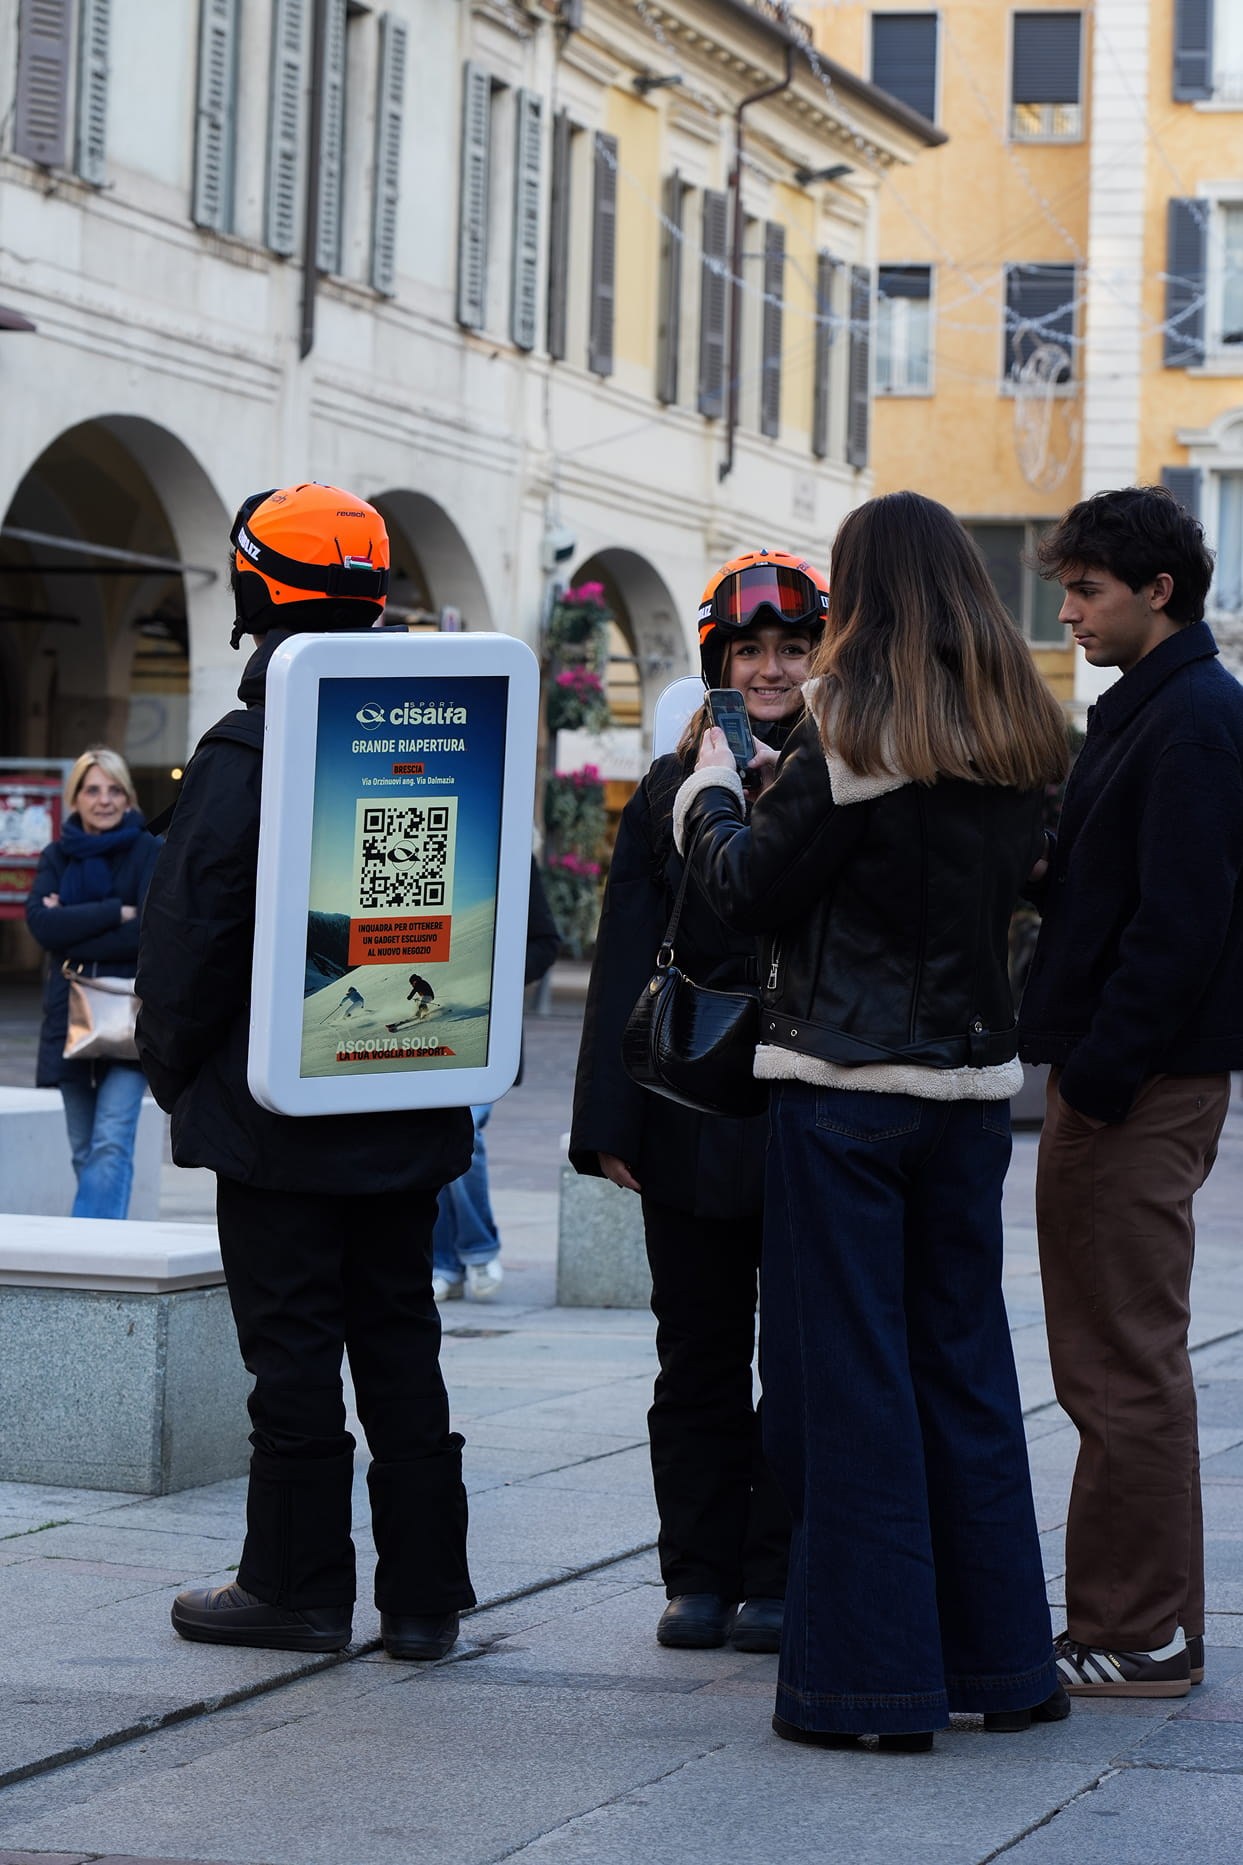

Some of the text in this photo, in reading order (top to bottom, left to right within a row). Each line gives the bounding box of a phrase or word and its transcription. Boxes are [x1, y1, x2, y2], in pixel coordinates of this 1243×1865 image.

[389, 702, 467, 725] cisalfa
[352, 740, 395, 753] GRANDE
[393, 765, 423, 774] BRESCIA
[361, 778, 372, 786] Via
[372, 777, 401, 786] Orzinuovi
[416, 776, 426, 784] Via
[358, 922, 443, 933] INQUADRA PER OTTENERE
[362, 934, 438, 944] UN GADGET ESCLUSIVO
[368, 946, 431, 956] AL NUOVO NEGOZIO
[336, 1036, 438, 1054] ASCOLTA SOLO
[340, 1052, 350, 1060] LA
[353, 1051, 370, 1060] TUA
[372, 1050, 404, 1059] VOGLIA
[406, 1048, 414, 1056] DI
